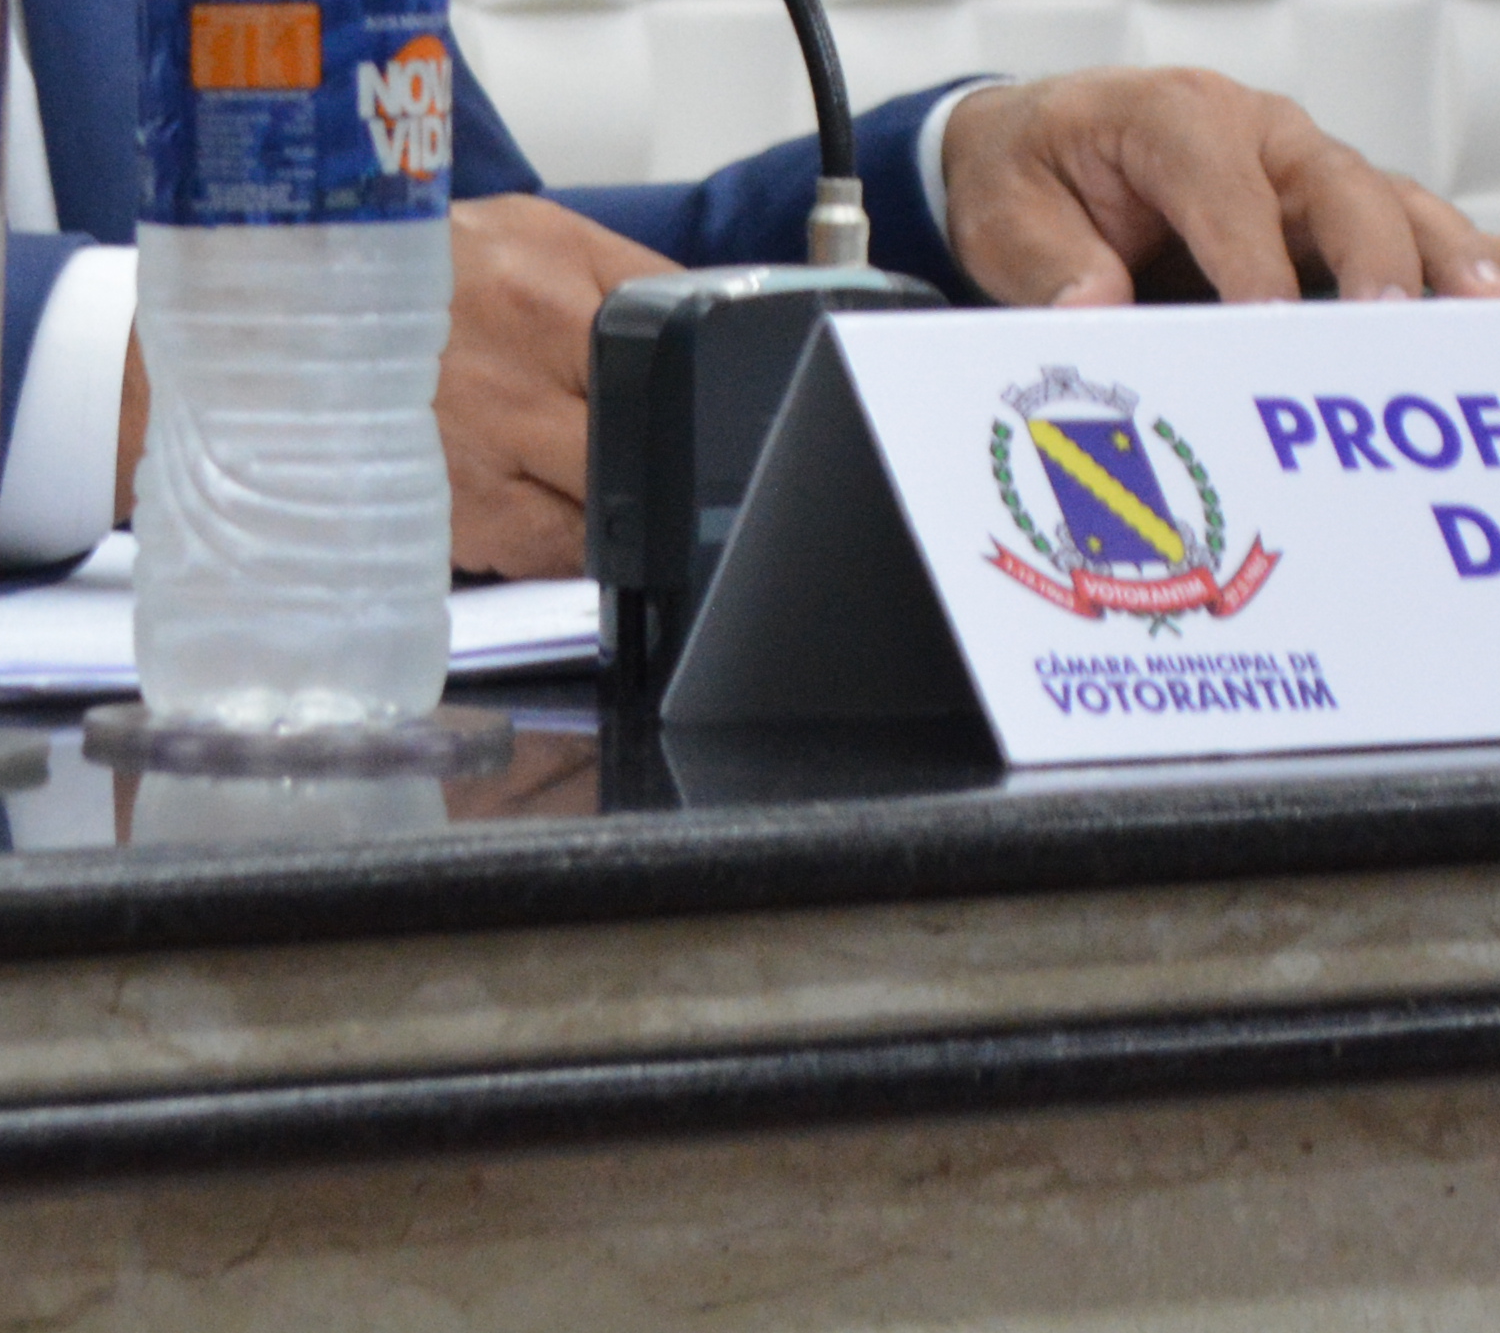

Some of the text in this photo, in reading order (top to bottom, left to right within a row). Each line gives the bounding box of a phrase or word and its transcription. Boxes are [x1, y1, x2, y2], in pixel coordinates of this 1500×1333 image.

[368, 115, 452, 175] VID
[1083, 576, 1210, 605] VOTORANTIM
[1034, 651, 1321, 677] CÂMARA MUNICIPAL DE
[1041, 677, 1338, 715] VOTORANTIM
